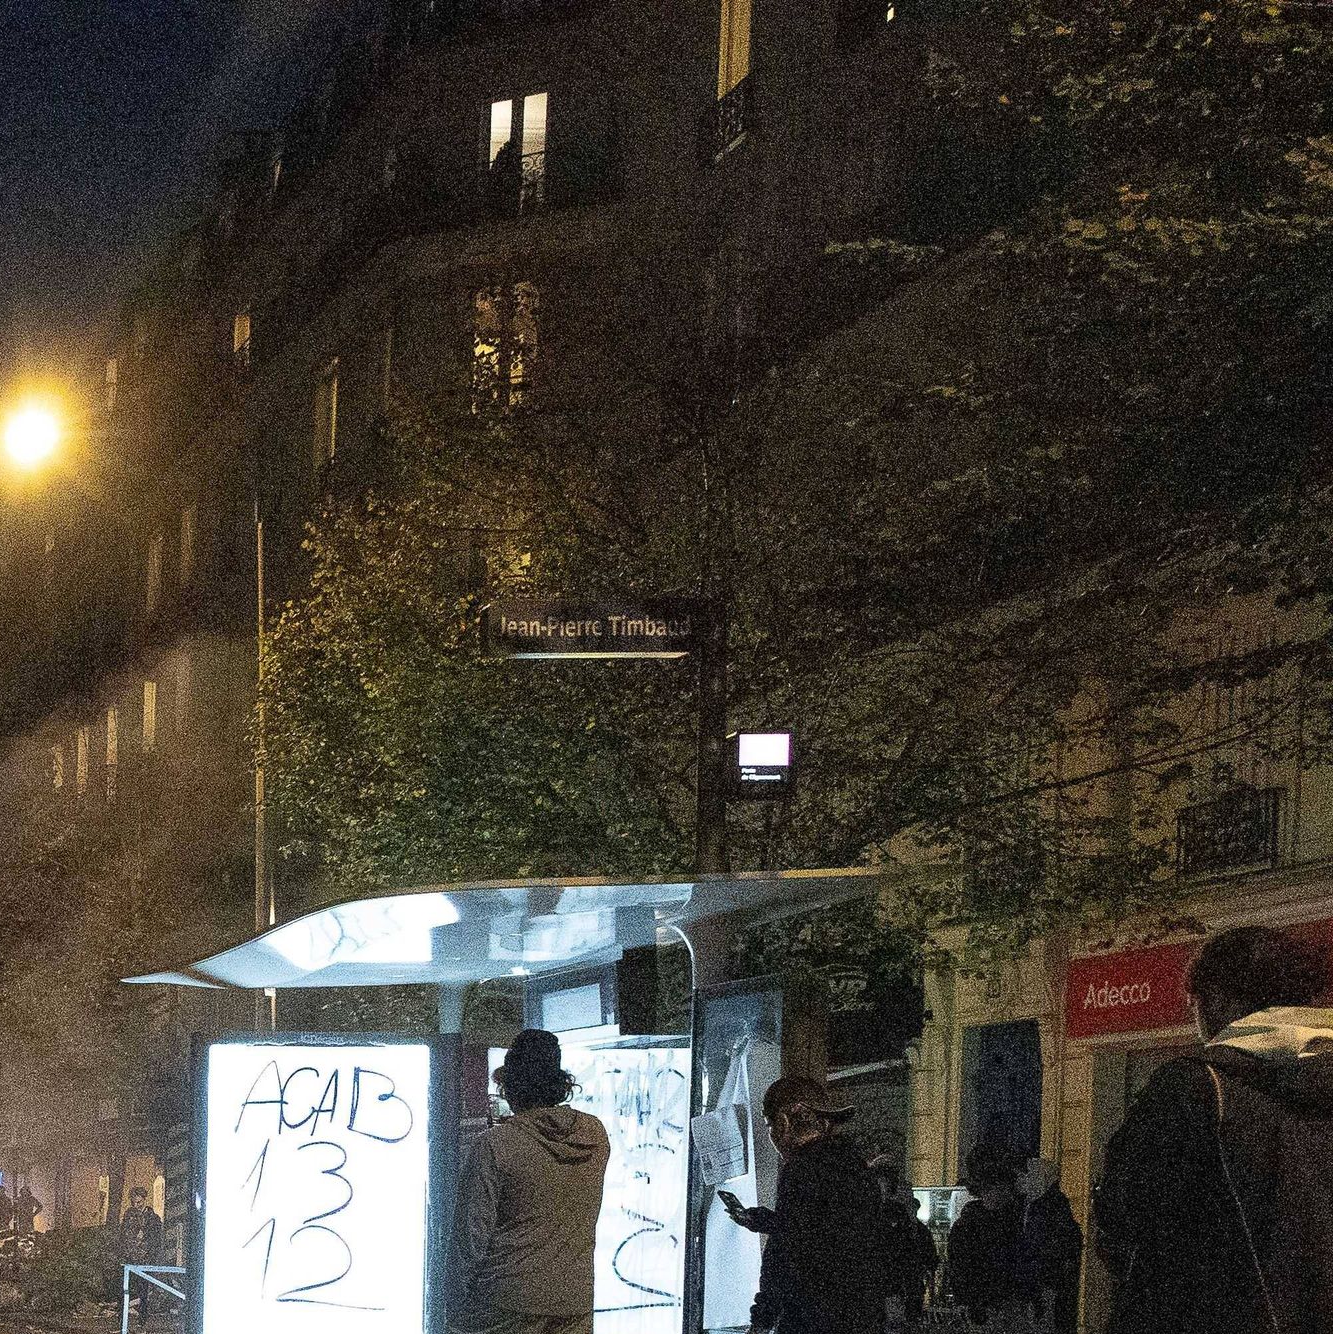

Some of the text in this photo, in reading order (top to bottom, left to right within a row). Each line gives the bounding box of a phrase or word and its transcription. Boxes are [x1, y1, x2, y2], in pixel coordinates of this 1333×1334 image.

[500, 613, 692, 638] Jean-Pierre Timbaud
[1083, 980, 1151, 1010] Adecco
[234, 1060, 414, 1143] ACAB
[241, 1138, 354, 1225] 13
[241, 1217, 386, 1312] 12
